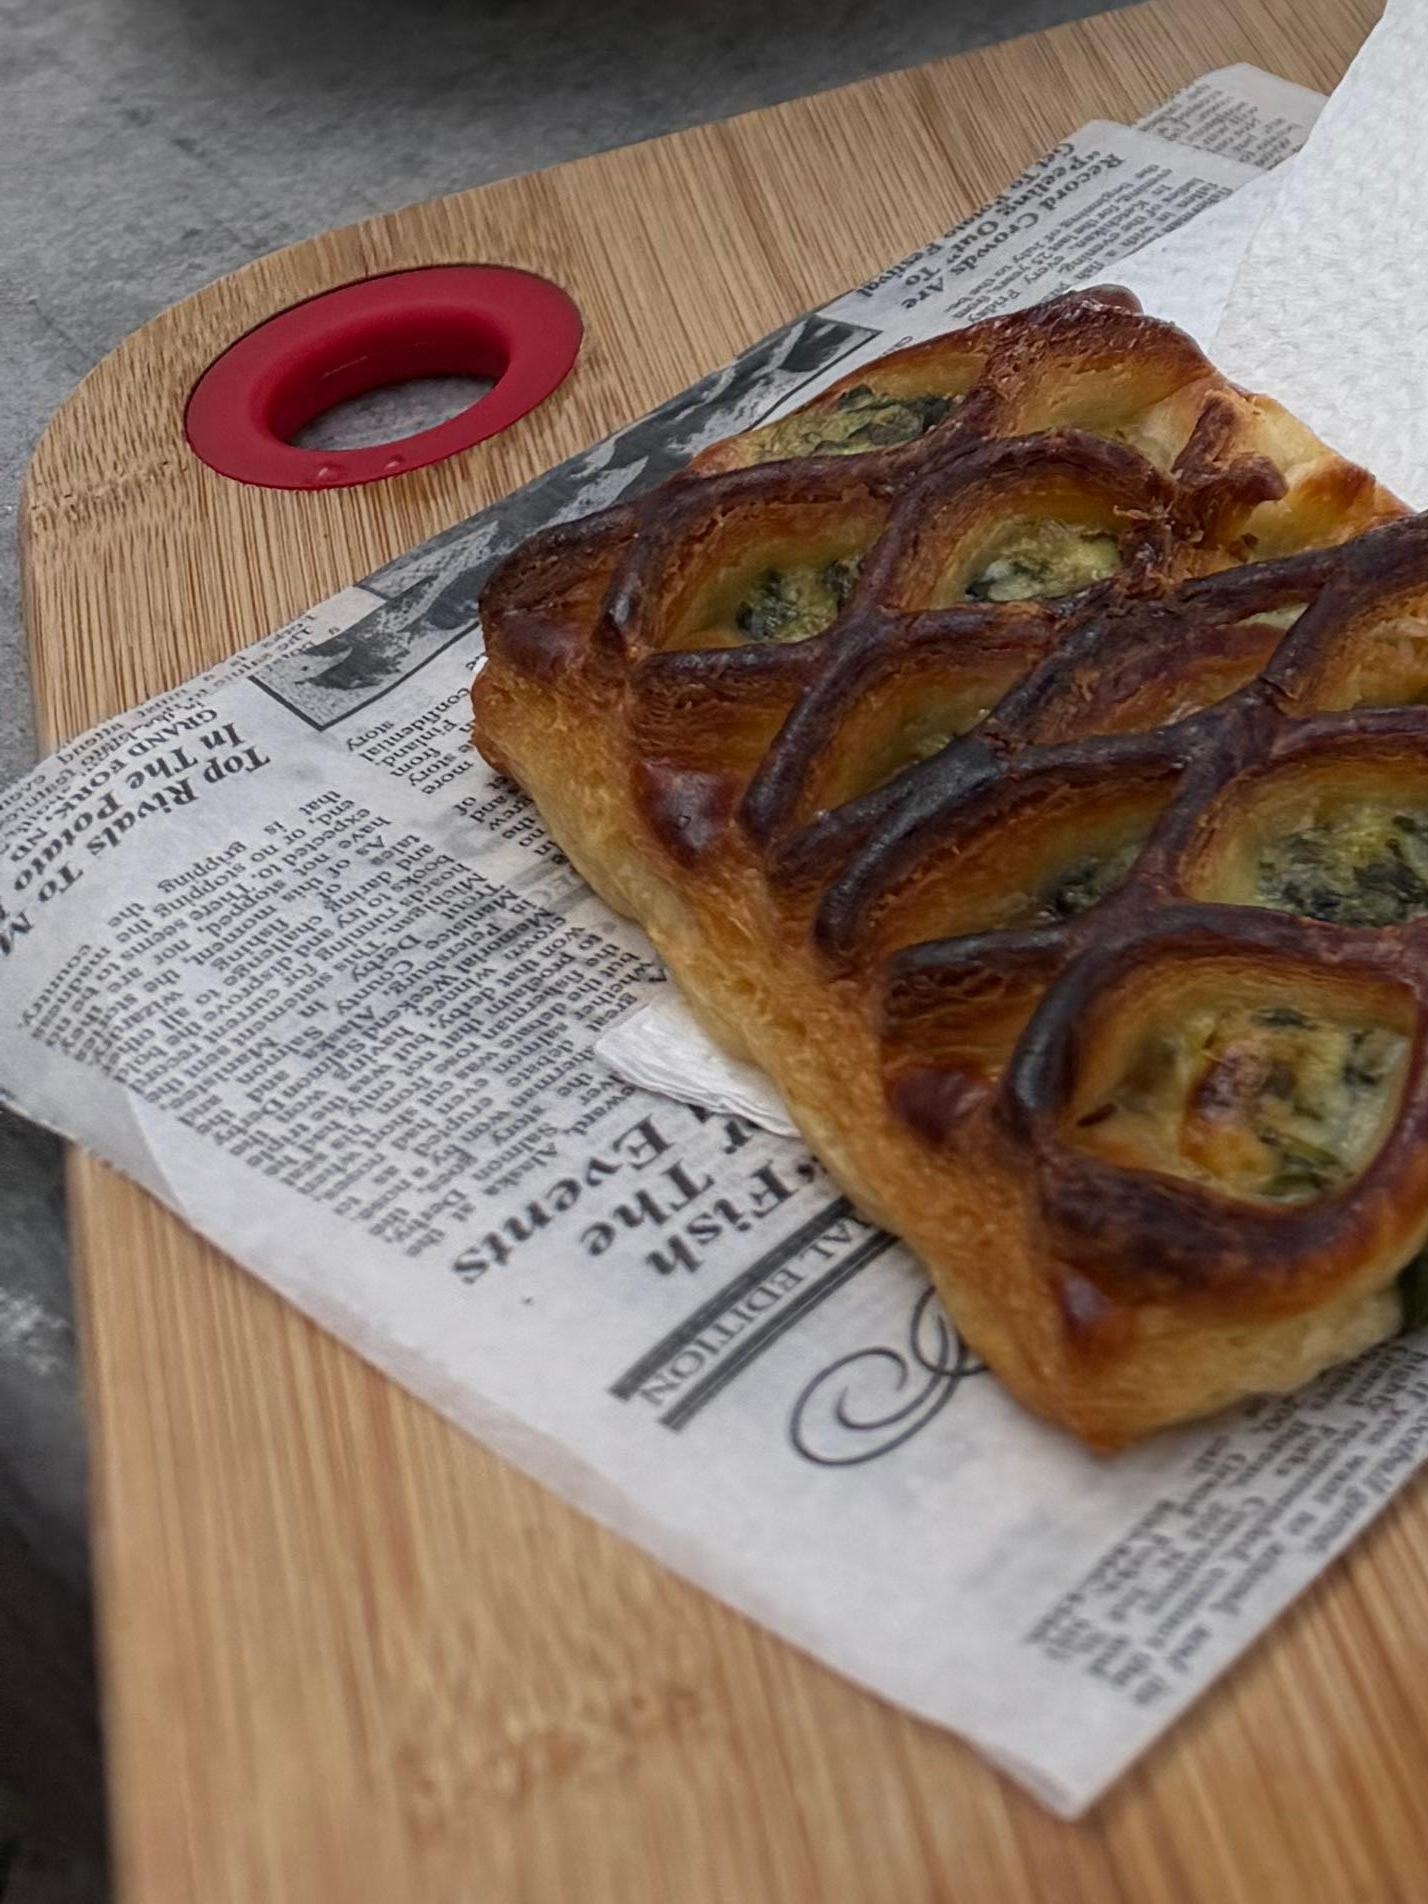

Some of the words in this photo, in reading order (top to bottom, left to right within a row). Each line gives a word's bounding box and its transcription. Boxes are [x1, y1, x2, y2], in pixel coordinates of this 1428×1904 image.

[1037, 152, 1126, 213] Record
[948, 211, 1041, 277] Crowds
[854, 240, 946, 299] Festival
[903, 265, 943, 288] To
[899, 275, 945, 311] Are
[126, 708, 219, 759] GRAND
[198, 721, 246, 752] In
[344, 719, 396, 754] story
[357, 686, 474, 764] confidential
[124, 745, 200, 791] The
[201, 745, 272, 785] Top
[388, 746, 443, 778] from
[406, 752, 458, 788] story
[419, 759, 475, 796] more
[44, 757, 129, 823] FORK,
[297, 789, 343, 817] that
[451, 795, 478, 818] of
[85, 775, 200, 857] Rivals
[306, 798, 356, 828] end,
[467, 794, 508, 824] and
[8, 826, 50, 864] ND
[12, 789, 124, 893] Potato
[262, 819, 289, 837] is
[279, 807, 372, 868] expected
[281, 827, 308, 847] or
[336, 814, 393, 851] have
[353, 833, 386, 858] As
[500, 815, 537, 841] the
[516, 826, 547, 849] no
[155, 839, 249, 895] gripping
[248, 843, 281, 864] no
[291, 851, 333, 878] not
[367, 833, 422, 868] tales
[36, 862, 85, 904] To
[249, 862, 284, 881] to.
[324, 858, 352, 881] of
[151, 861, 248, 920] stopping
[187, 881, 258, 923] There
[279, 875, 325, 904] this
[315, 882, 343, 908] of
[106, 901, 147, 929] the
[195, 878, 288, 939] stopped,
[114, 917, 155, 945] the
[118, 917, 190, 963] seems
[180, 903, 279, 966] moment,
[209, 916, 291, 974] fishing
[151, 937, 193, 967] nor
[94, 961, 122, 983] to
[104, 965, 145, 995] are
[141, 967, 182, 995] the
[29, 945, 113, 1042] madness
[69, 985, 102, 1015] be
[43, 1015, 74, 1049] no
[57, 1003, 105, 1057] they
[72, 991, 140, 1064] stories
[451, 1113, 676, 1286] Events
[579, 1158, 717, 1258] The
[632, 1255, 807, 1408] EDITION
